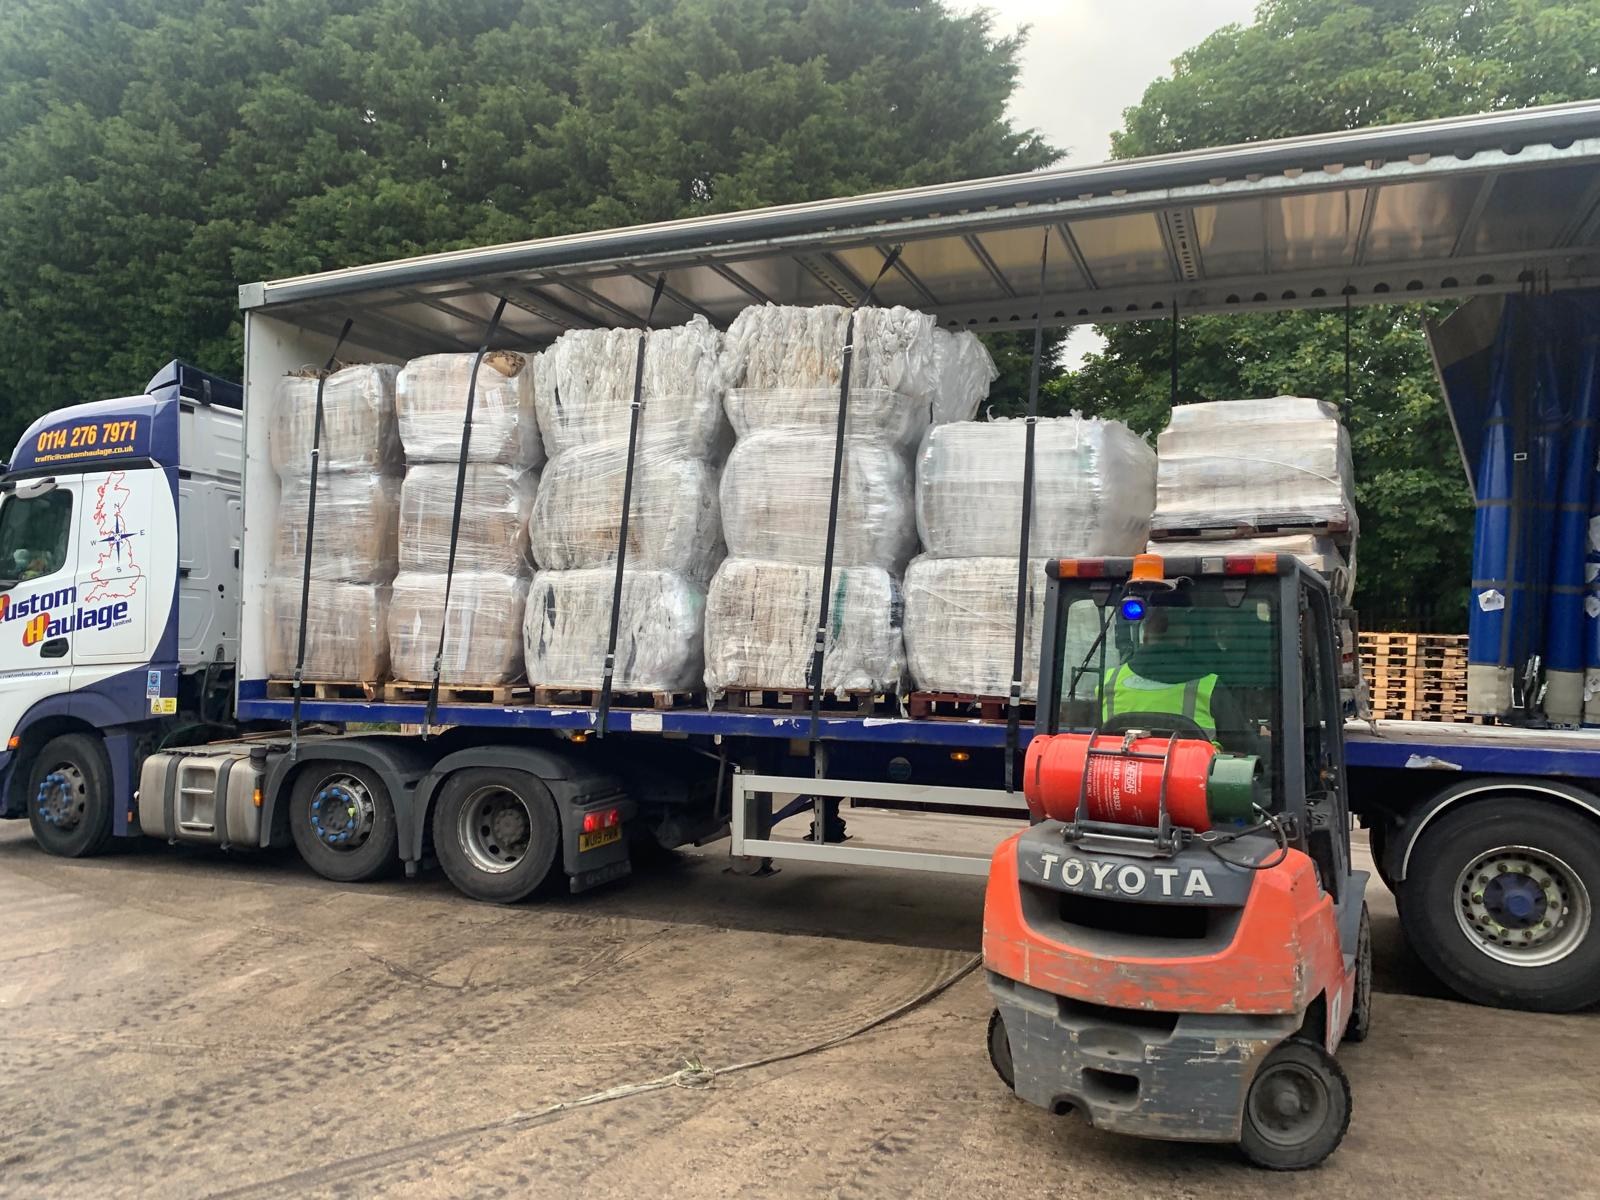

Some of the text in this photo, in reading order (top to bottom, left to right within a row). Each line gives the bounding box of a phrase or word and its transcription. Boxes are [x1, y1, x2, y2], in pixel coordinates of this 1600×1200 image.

[37, 421, 137, 452] 0114 276 7971
[0, 586, 77, 622] ustom
[27, 602, 128, 644] Haulage
[1041, 853, 1213, 896] TOYOTA
